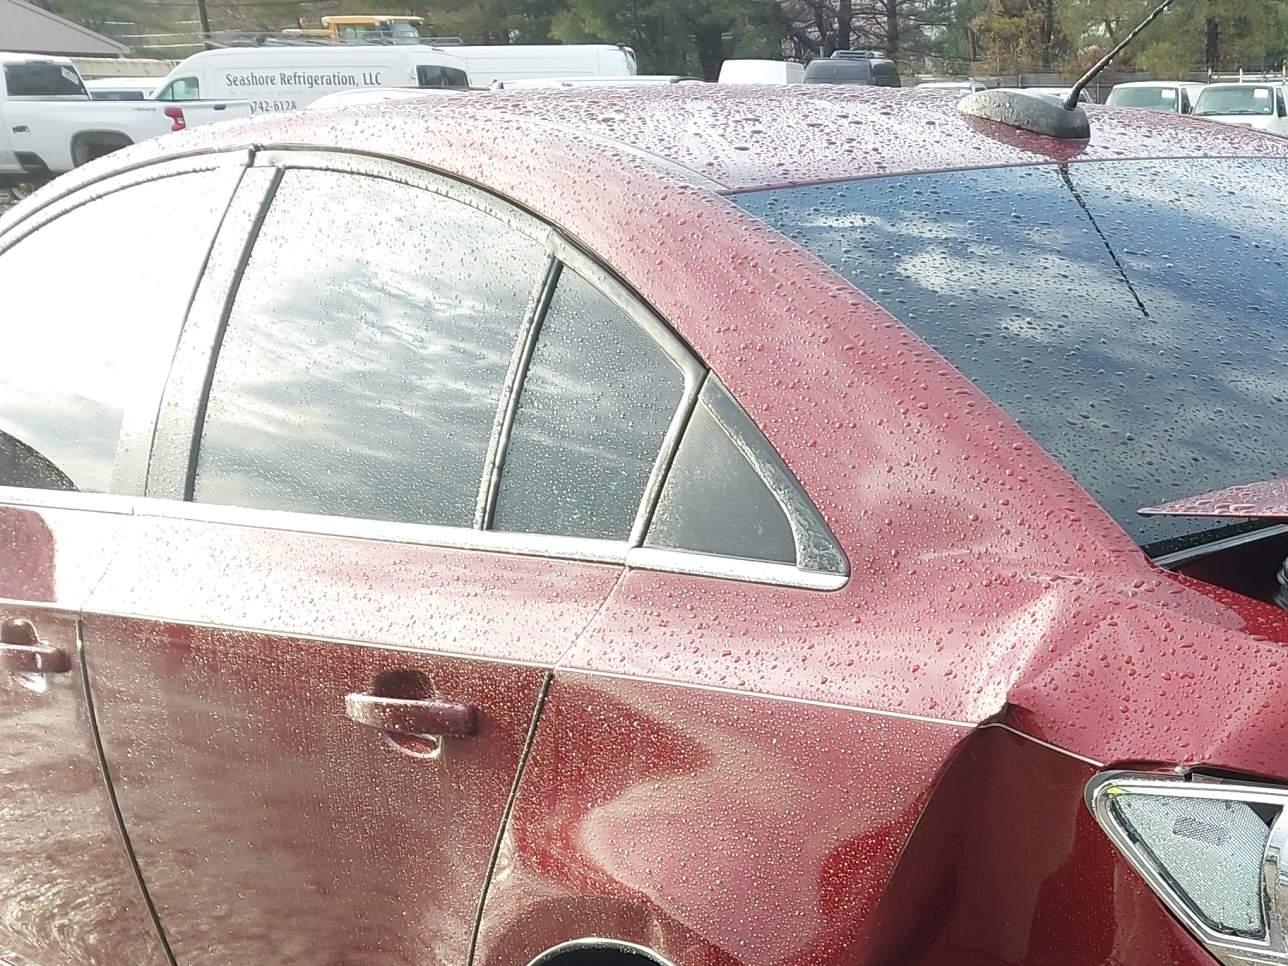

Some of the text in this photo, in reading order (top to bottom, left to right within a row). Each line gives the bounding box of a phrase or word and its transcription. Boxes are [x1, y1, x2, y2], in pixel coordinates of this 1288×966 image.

[225, 71, 382, 88] Seashore Refrigeration, LLC
